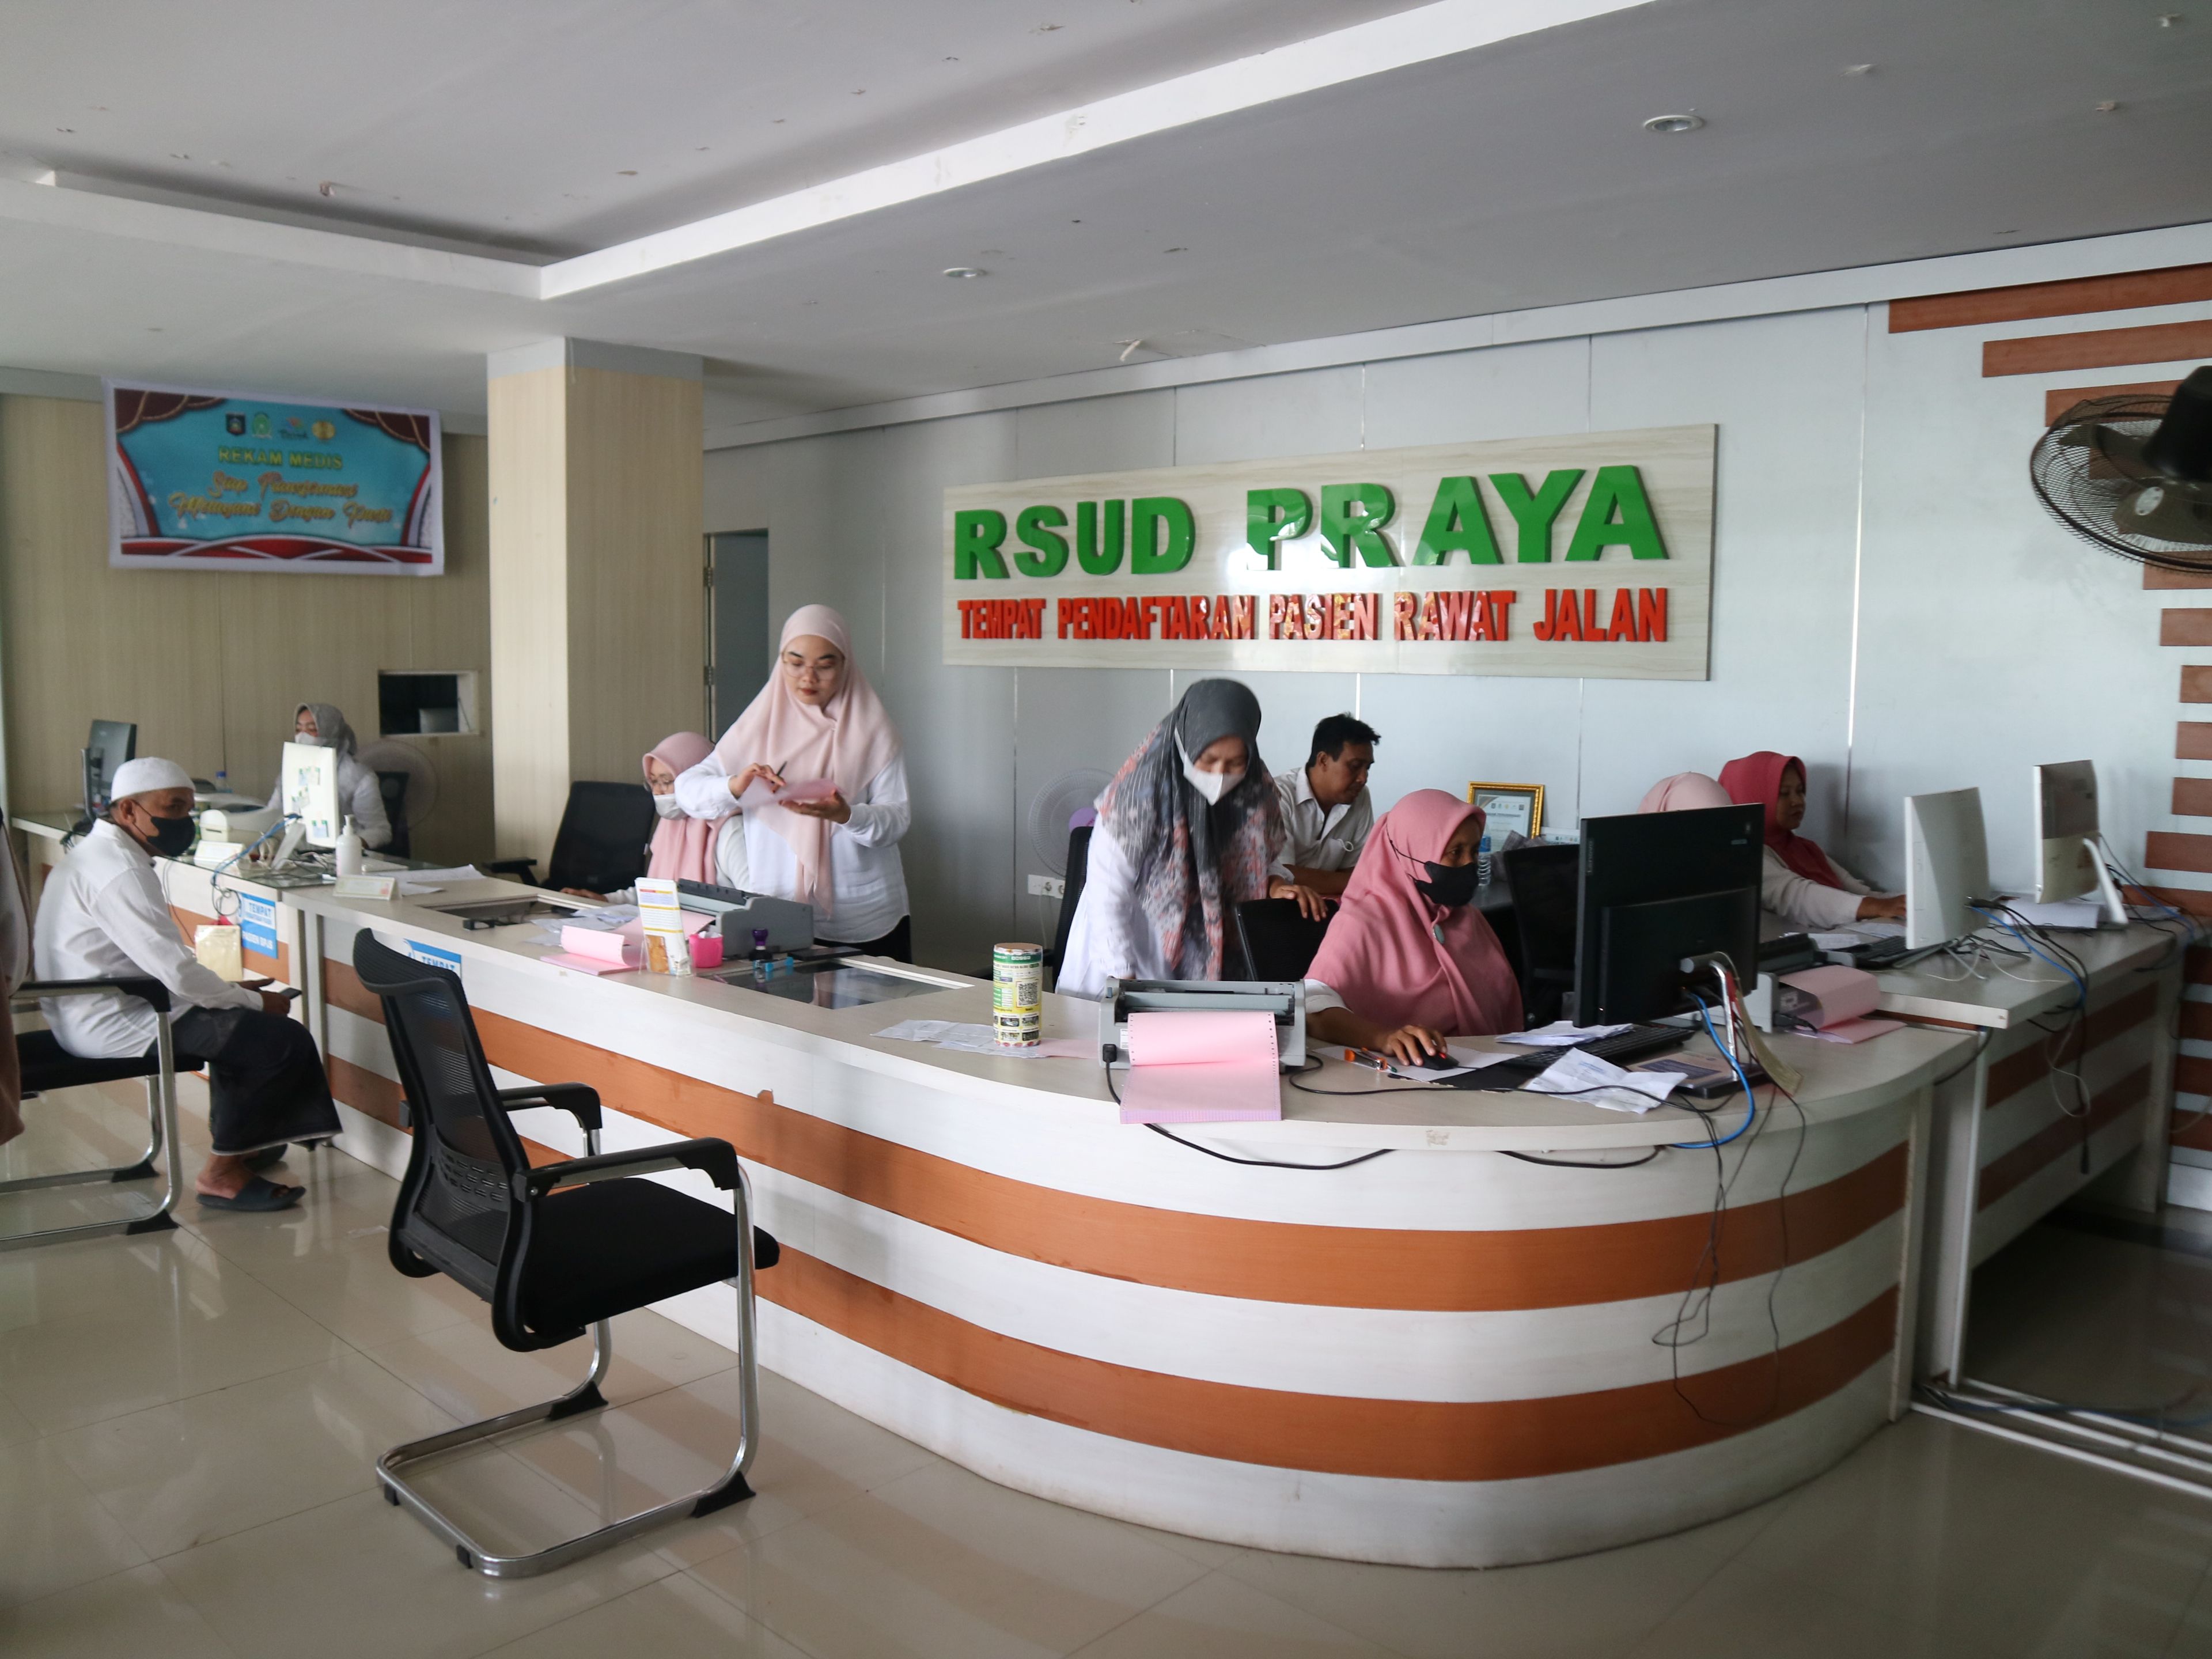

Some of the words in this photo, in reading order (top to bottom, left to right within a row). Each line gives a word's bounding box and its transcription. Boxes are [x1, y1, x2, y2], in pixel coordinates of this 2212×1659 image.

[218, 446, 282, 465] REKAM
[290, 450, 343, 469] MEDIS
[955, 497, 1195, 579] RSUD
[1247, 465, 1669, 570] PRAYA
[957, 597, 1047, 639] TEMPAT
[1057, 594, 1256, 640] PENDAFTARAN
[1270, 593, 1380, 641] PASIEN
[1394, 590, 1517, 641] RAWAT
[1533, 588, 1668, 642] JALAN
[249, 902, 272, 917] TEMPAT
